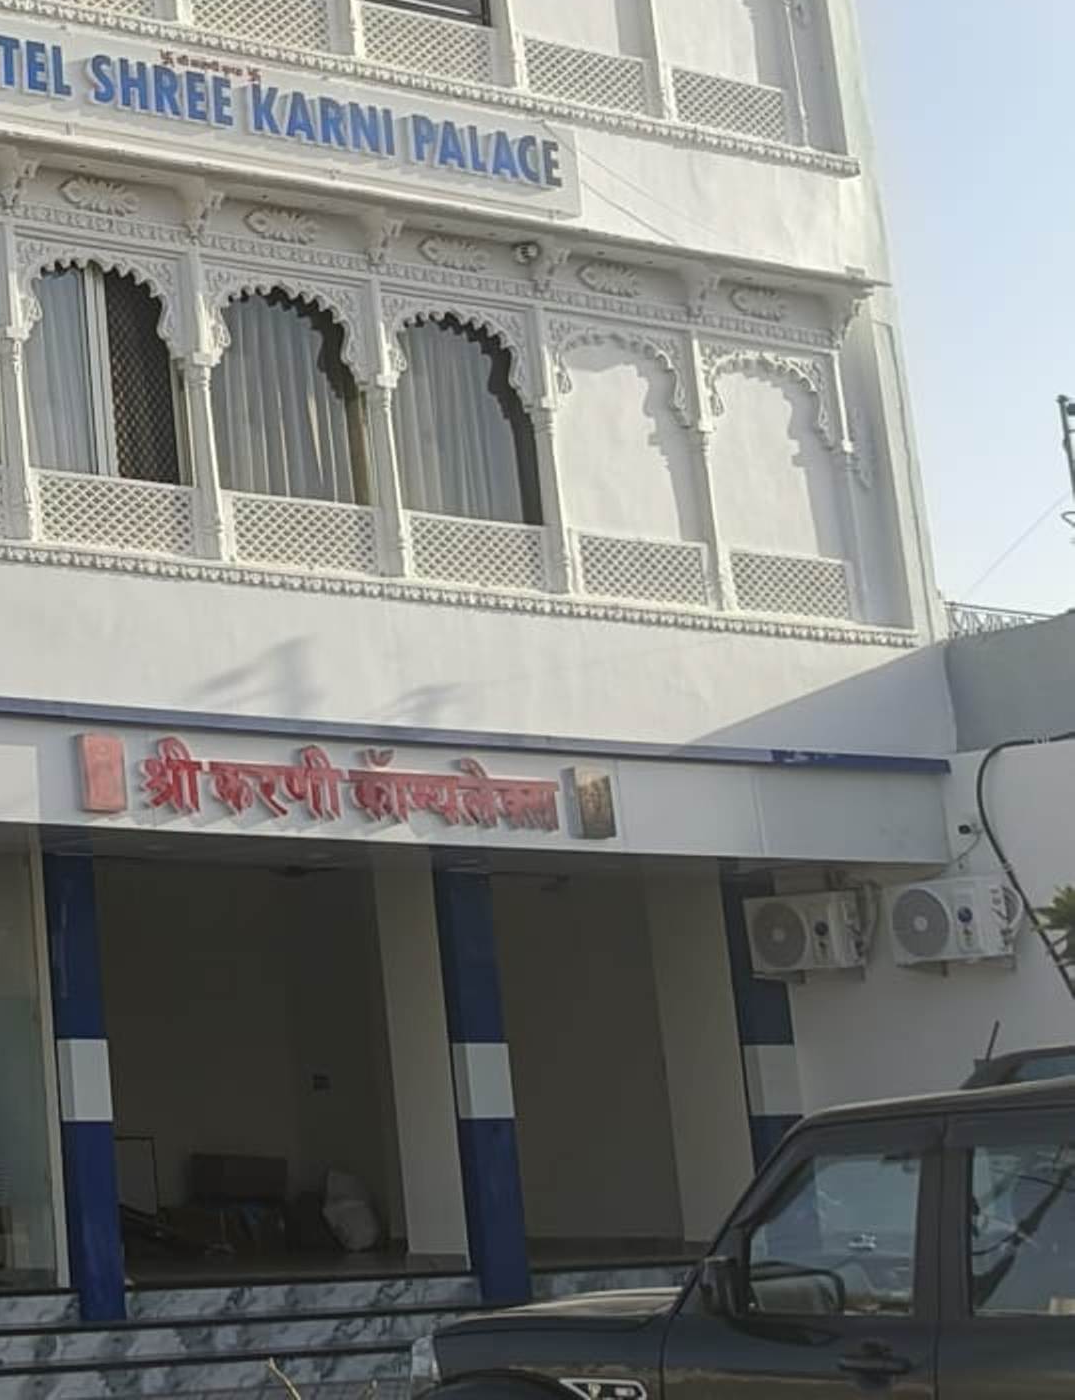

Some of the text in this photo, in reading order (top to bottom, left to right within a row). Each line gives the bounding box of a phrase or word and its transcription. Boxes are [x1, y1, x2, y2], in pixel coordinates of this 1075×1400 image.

[90, 54, 234, 127] SHREE
[250, 83, 396, 156] KARNI
[412, 113, 562, 188] PALACE
[142, 735, 203, 812] श्री
